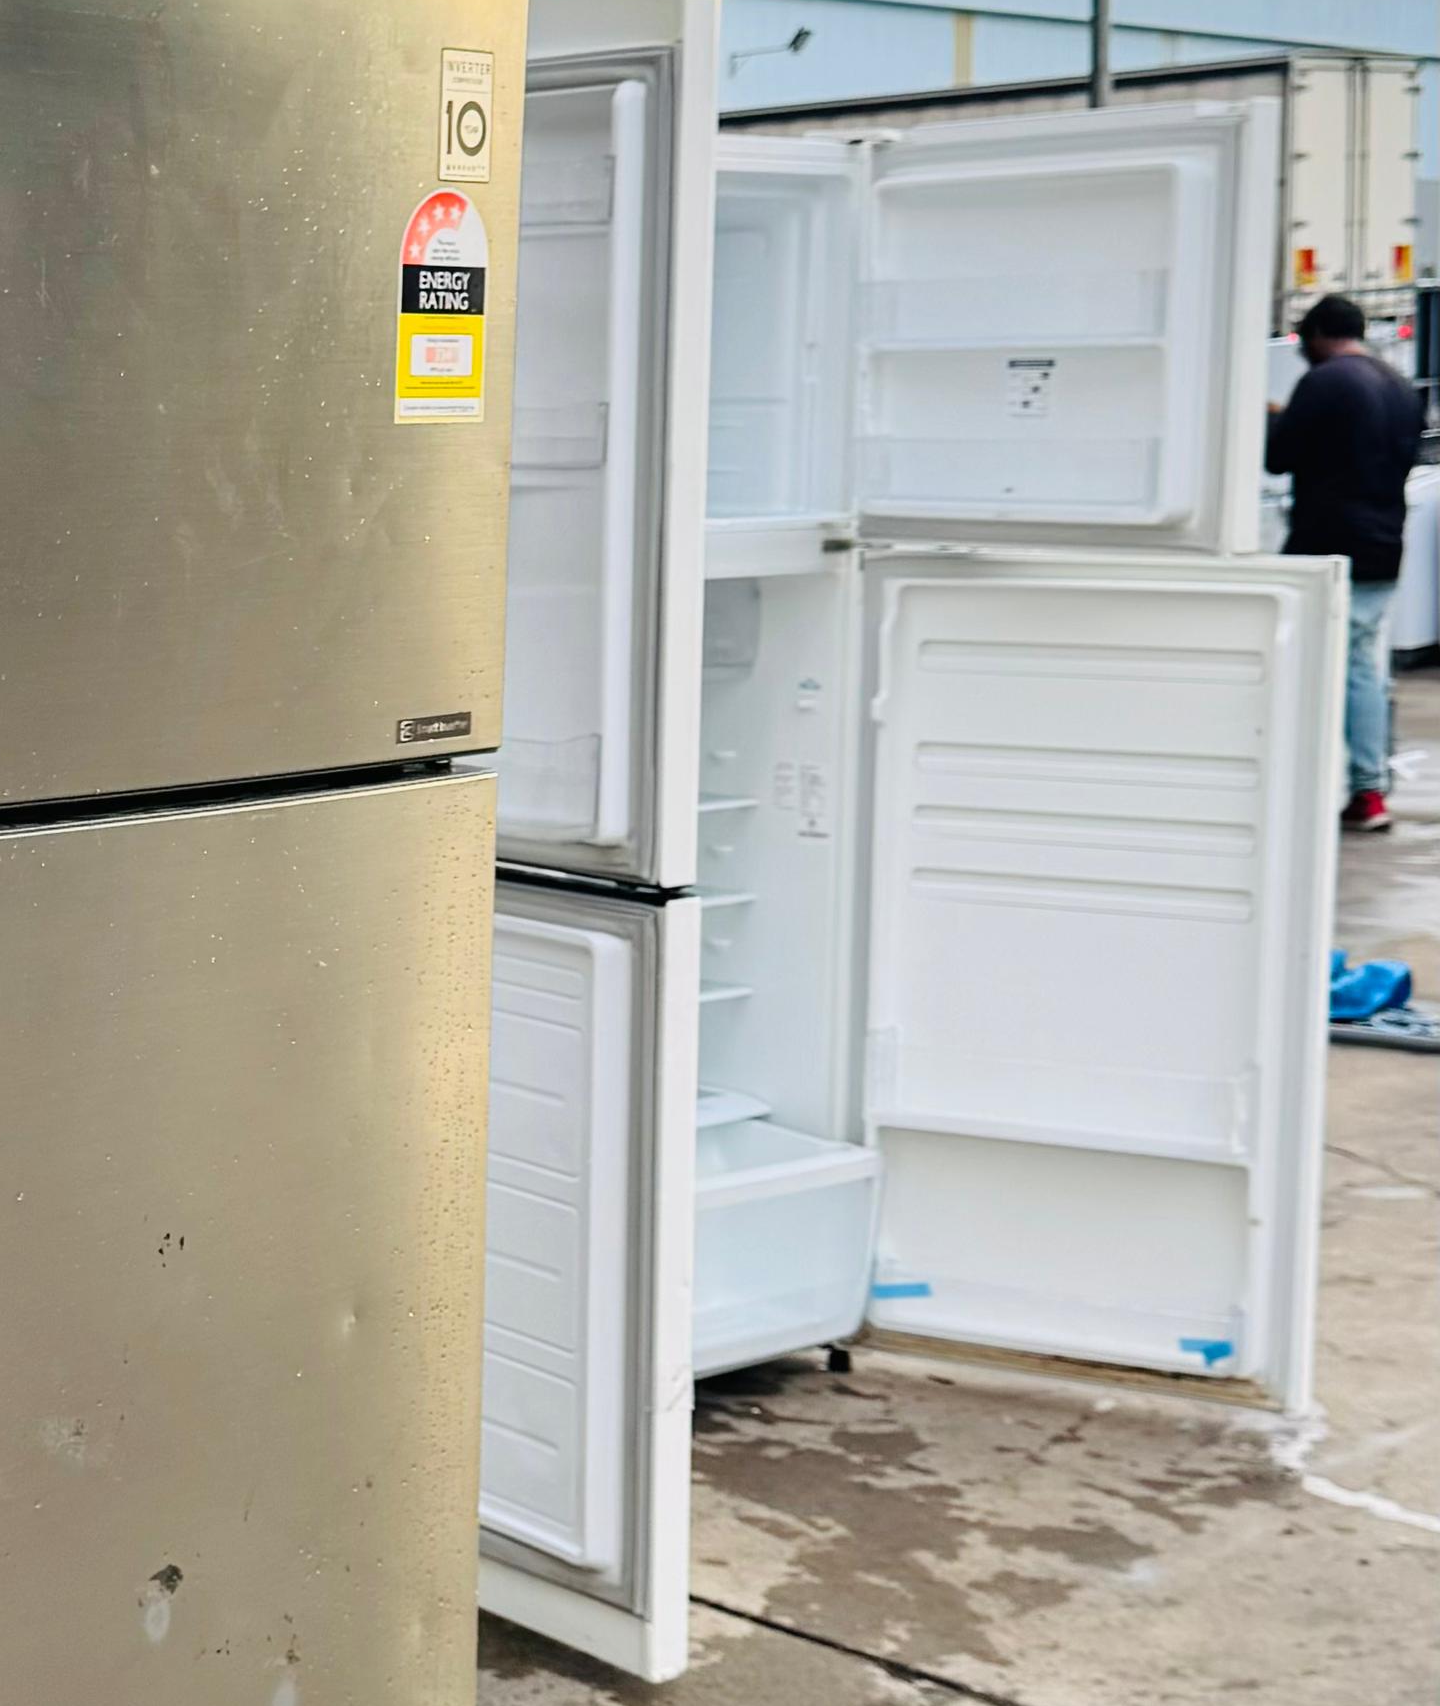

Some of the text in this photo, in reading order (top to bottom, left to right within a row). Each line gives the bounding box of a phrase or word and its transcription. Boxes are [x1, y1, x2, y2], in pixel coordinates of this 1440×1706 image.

[446, 100, 487, 157] 10
[419, 270, 471, 291] ENERGY
[419, 291, 469, 311] RATING
